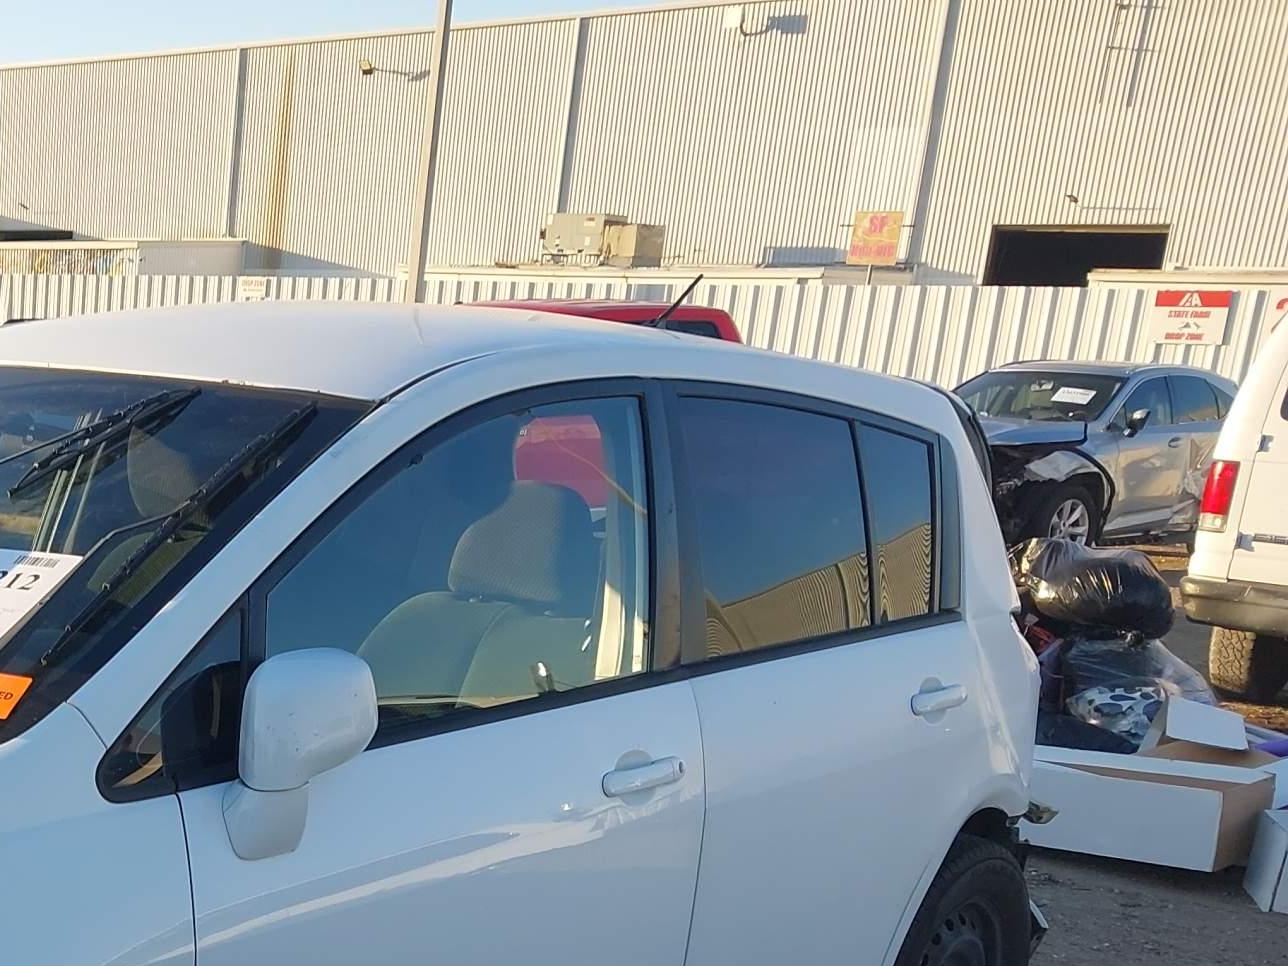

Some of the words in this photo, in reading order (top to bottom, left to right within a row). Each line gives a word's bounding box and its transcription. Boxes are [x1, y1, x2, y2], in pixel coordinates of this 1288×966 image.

[1167, 310, 1190, 319] STATE
[1191, 310, 1212, 319] FARM
[1164, 332, 1185, 340] DROP
[1186, 332, 1205, 341] ZONE
